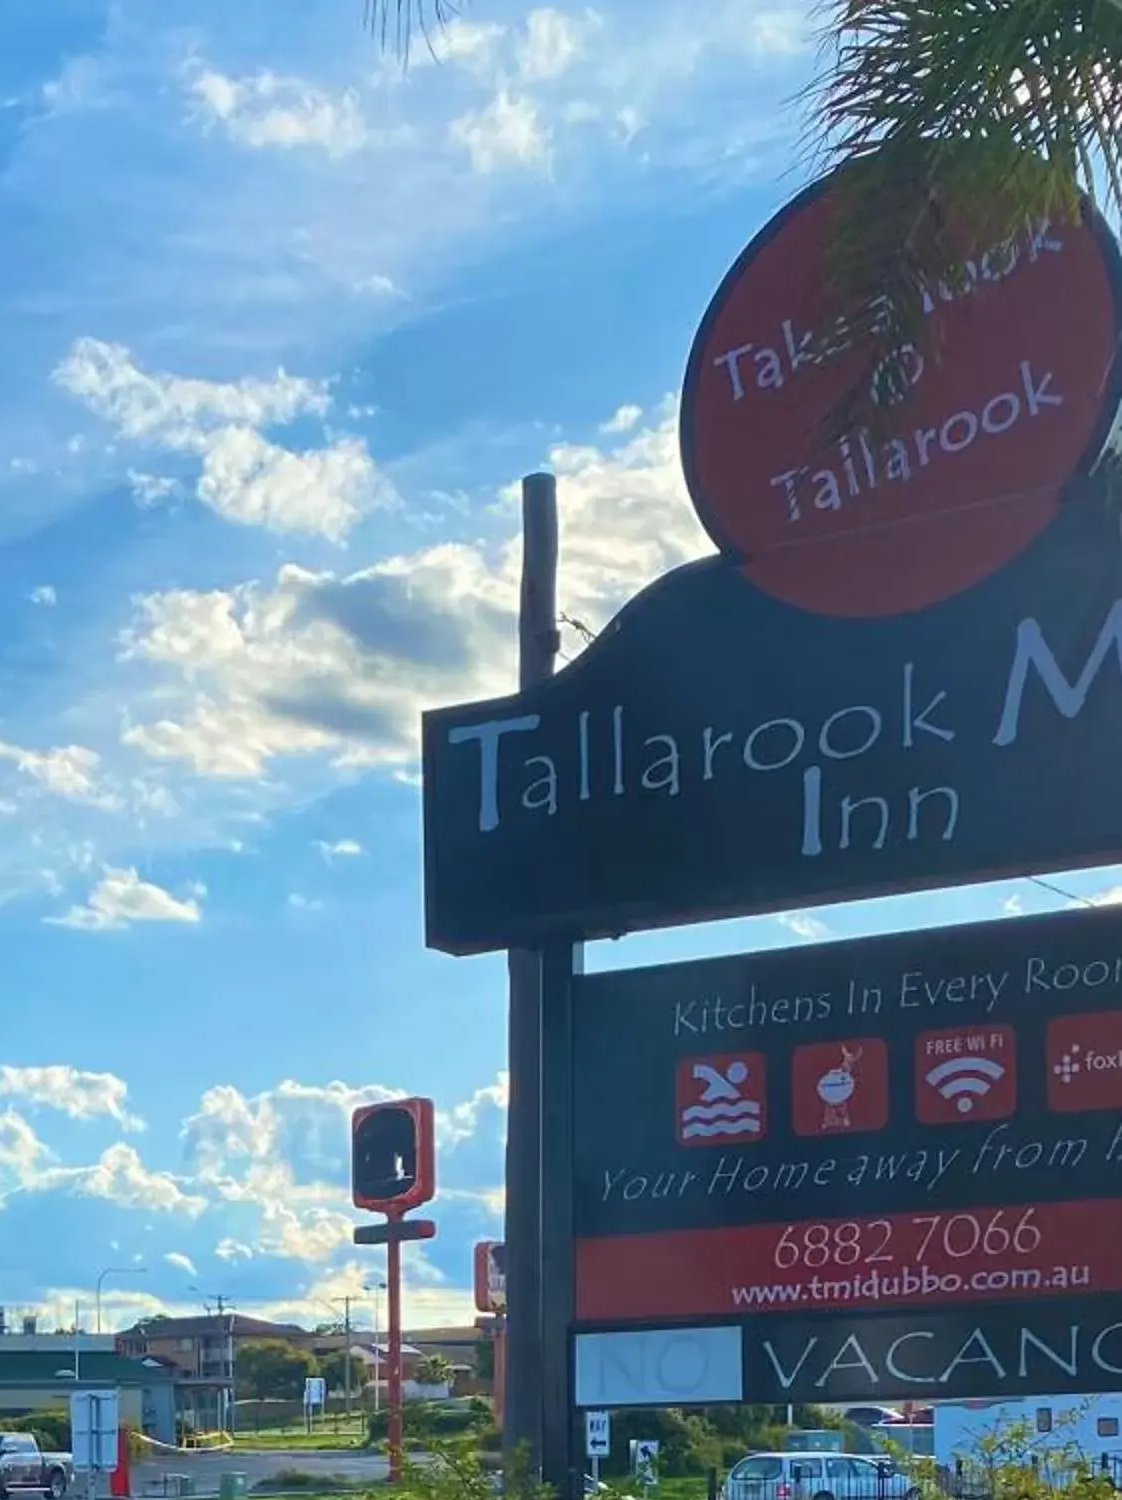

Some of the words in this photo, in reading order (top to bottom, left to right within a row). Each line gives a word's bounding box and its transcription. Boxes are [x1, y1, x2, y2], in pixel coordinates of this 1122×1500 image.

[448, 662, 955, 831] Tallarook
[802, 765, 960, 856] Inn
[674, 984, 832, 1036] Kitchens
[848, 980, 882, 1016] In
[900, 969, 1009, 1013] Every
[1025, 957, 1122, 993] Roo
[926, 1038, 963, 1055] FREE
[602, 1165, 696, 1201] Your
[707, 1149, 837, 1196] Home
[847, 1146, 959, 1190] away
[973, 1123, 1088, 1173] from
[774, 1220, 894, 1269] 6882
[912, 1207, 1043, 1262] 7066
[731, 1263, 1090, 1305] www.tmidubbo.com.au
[596, 1333, 710, 1397] NO
